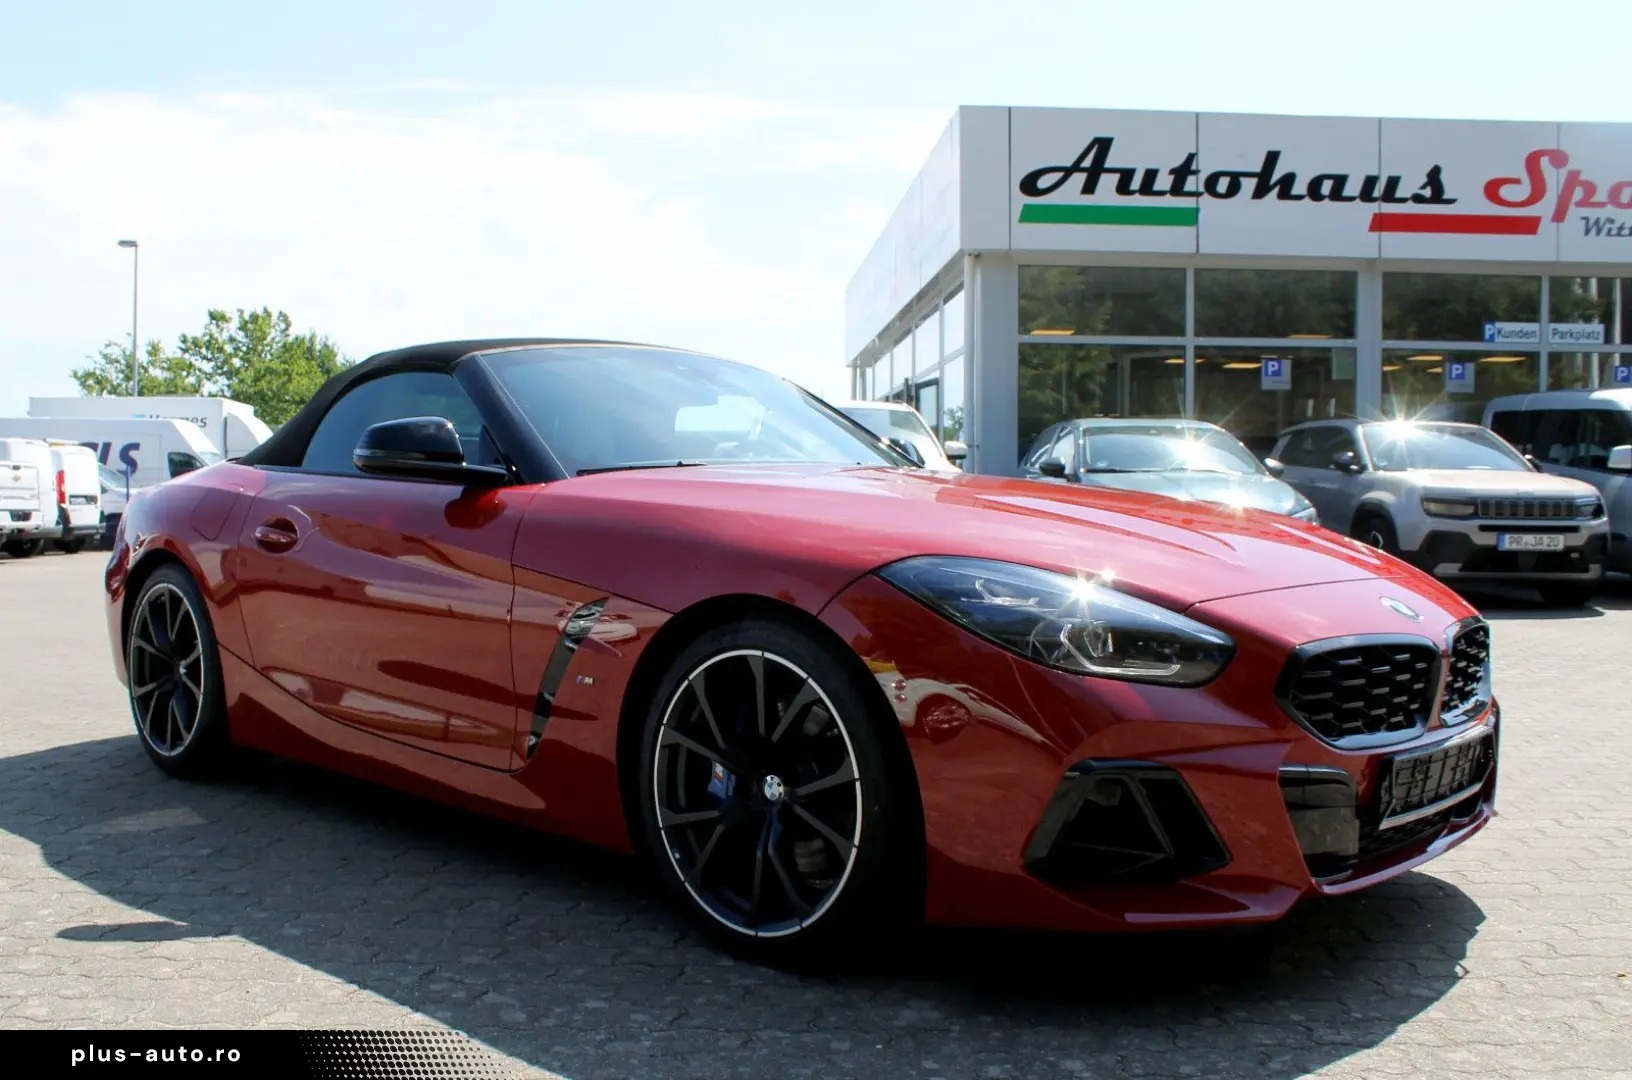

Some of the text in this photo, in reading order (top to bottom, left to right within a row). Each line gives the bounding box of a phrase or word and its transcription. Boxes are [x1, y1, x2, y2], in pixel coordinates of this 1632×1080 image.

[1019, 137, 1458, 205] Autohaus
[1497, 327, 1537, 339] Kunden
[1551, 328, 1601, 341] Parkplatz
[1267, 361, 1279, 376] P
[1451, 364, 1463, 379] P
[1617, 367, 1628, 380] P
